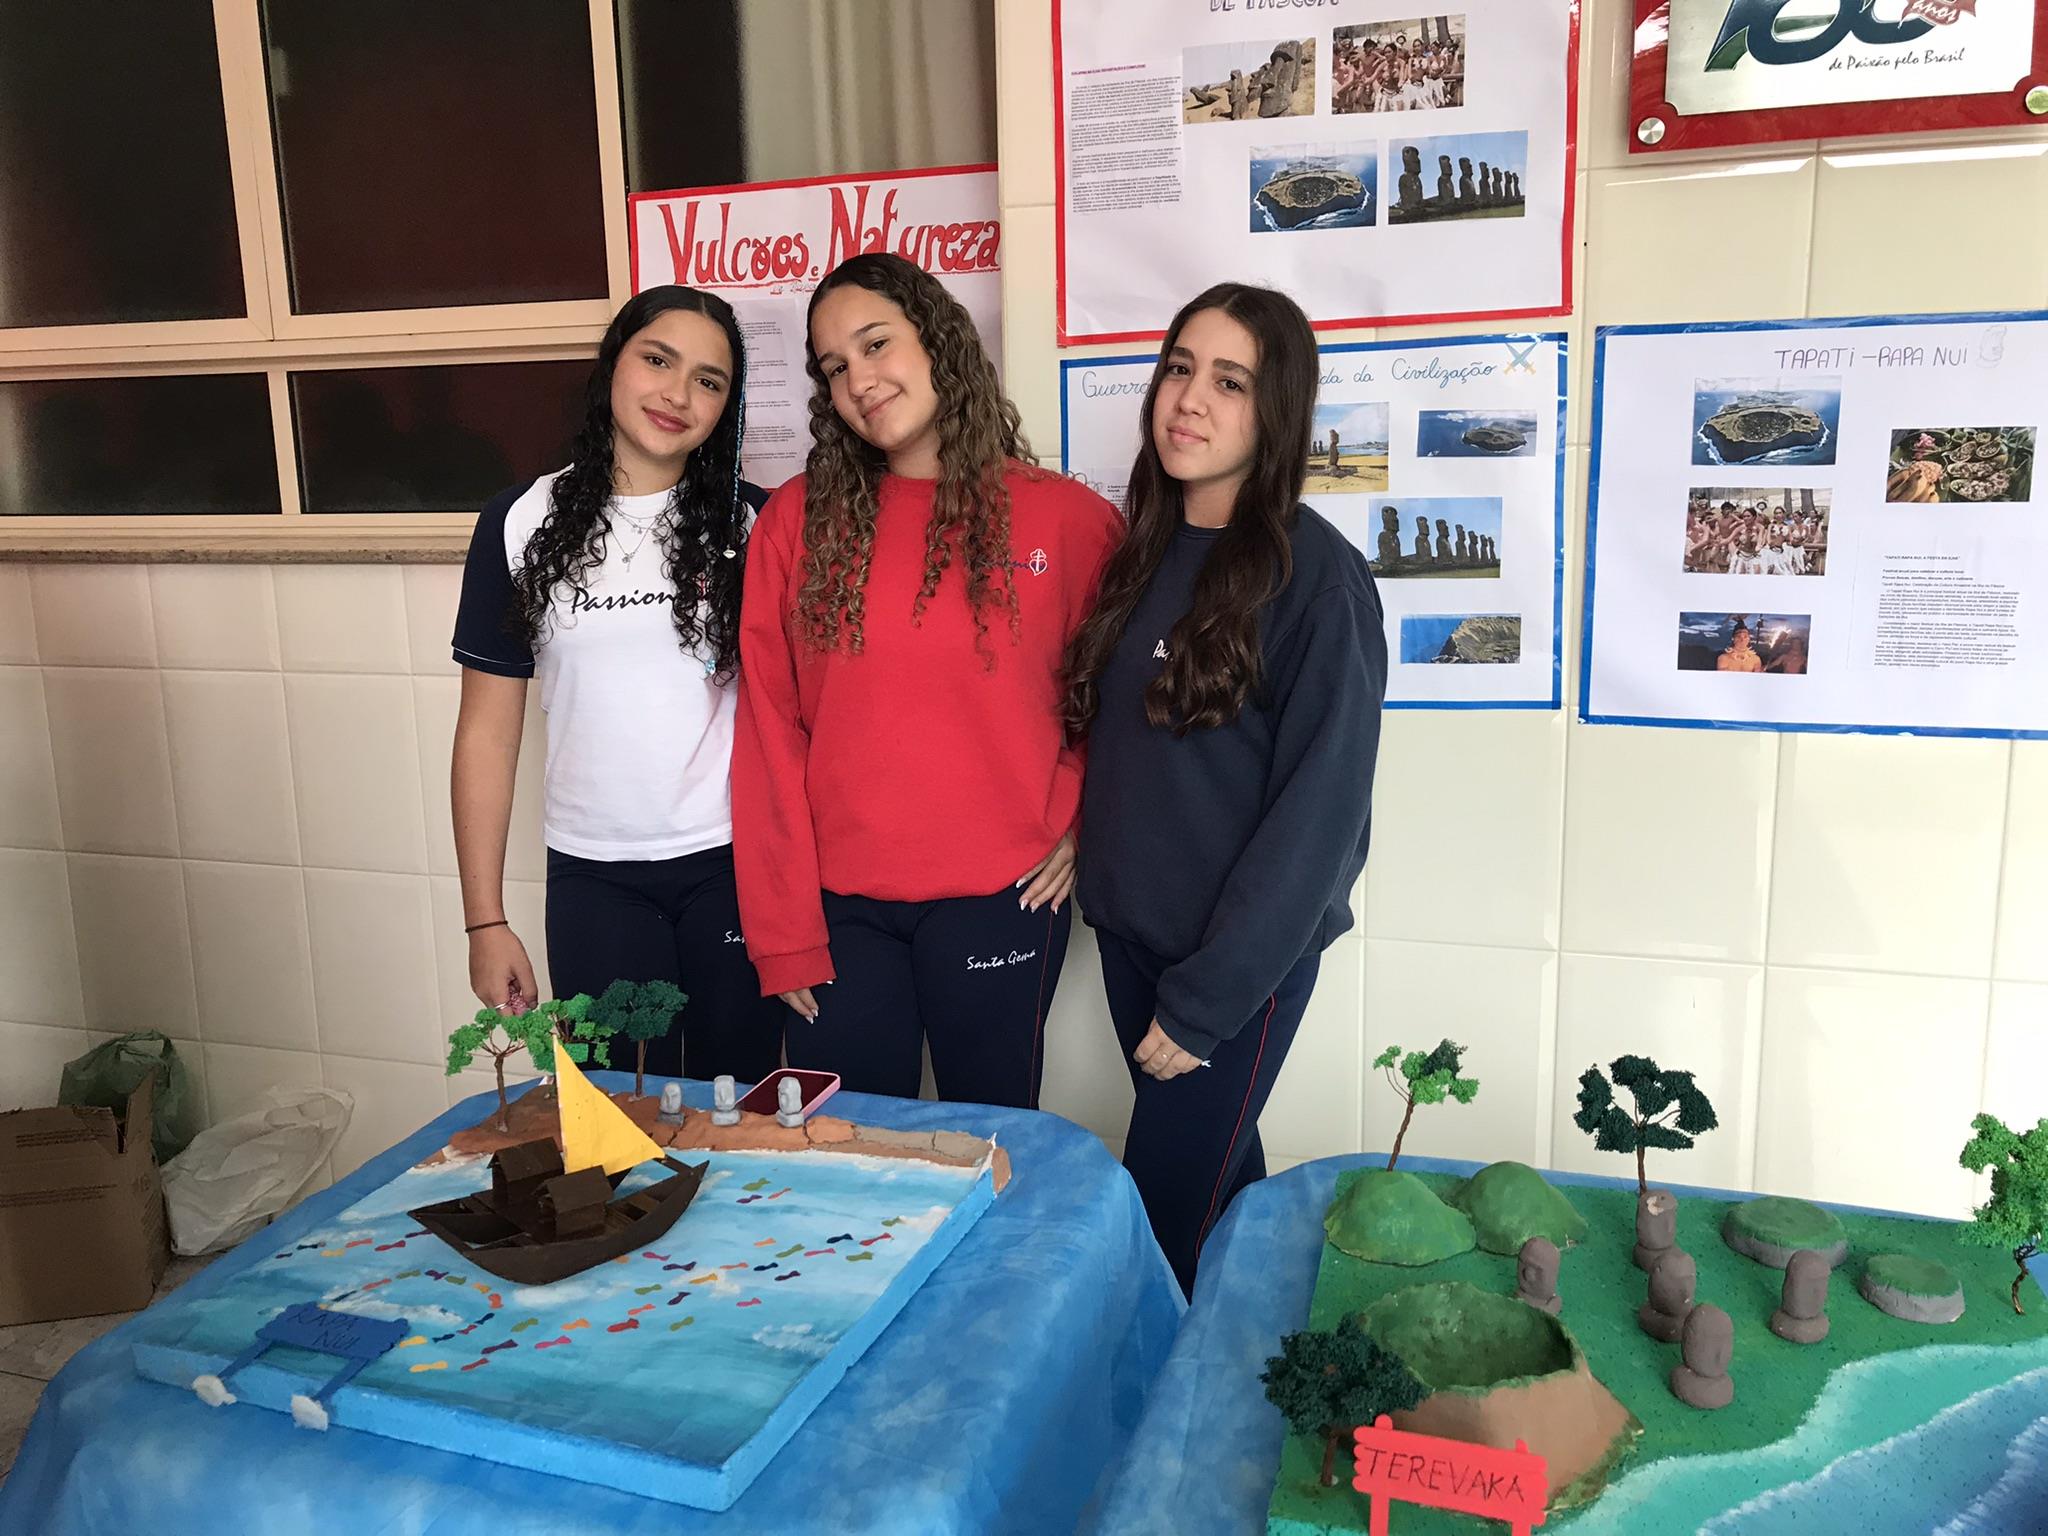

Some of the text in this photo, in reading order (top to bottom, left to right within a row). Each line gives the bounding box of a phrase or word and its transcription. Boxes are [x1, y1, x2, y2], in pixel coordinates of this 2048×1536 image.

[1911, 1, 1957, 22] anos
[1828, 47, 1966, 71] de Paixão pelo Brasil
[810, 264, 819, 277] e
[1353, 363, 1374, 383] da
[1391, 356, 1498, 389] Civilização
[966, 955, 1005, 970] Santa
[1364, 1446, 1525, 1503] TEREVAKA
